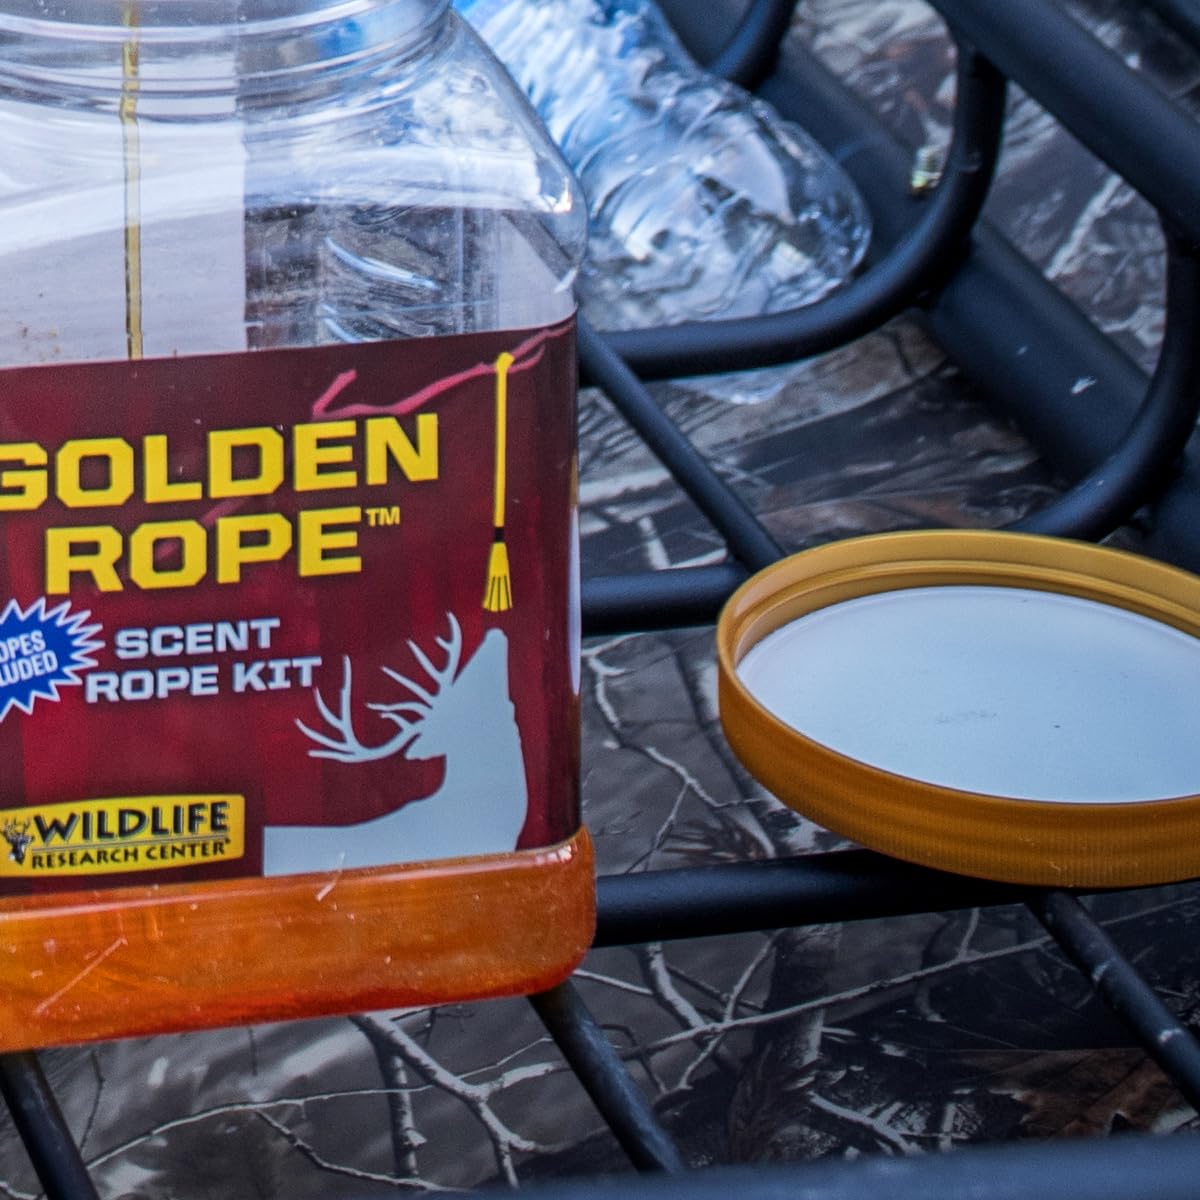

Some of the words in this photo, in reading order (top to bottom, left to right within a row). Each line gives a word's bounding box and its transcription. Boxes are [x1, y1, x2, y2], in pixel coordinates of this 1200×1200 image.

[45, 506, 362, 595] ROPE
[115, 618, 280, 659] SCENT
[85, 665, 220, 703] ROPE
[233, 656, 322, 693] KIT
[33, 801, 229, 842] WILDLIFE
[32, 846, 138, 870] RESEARCH
[145, 840, 228, 861] CENTER
